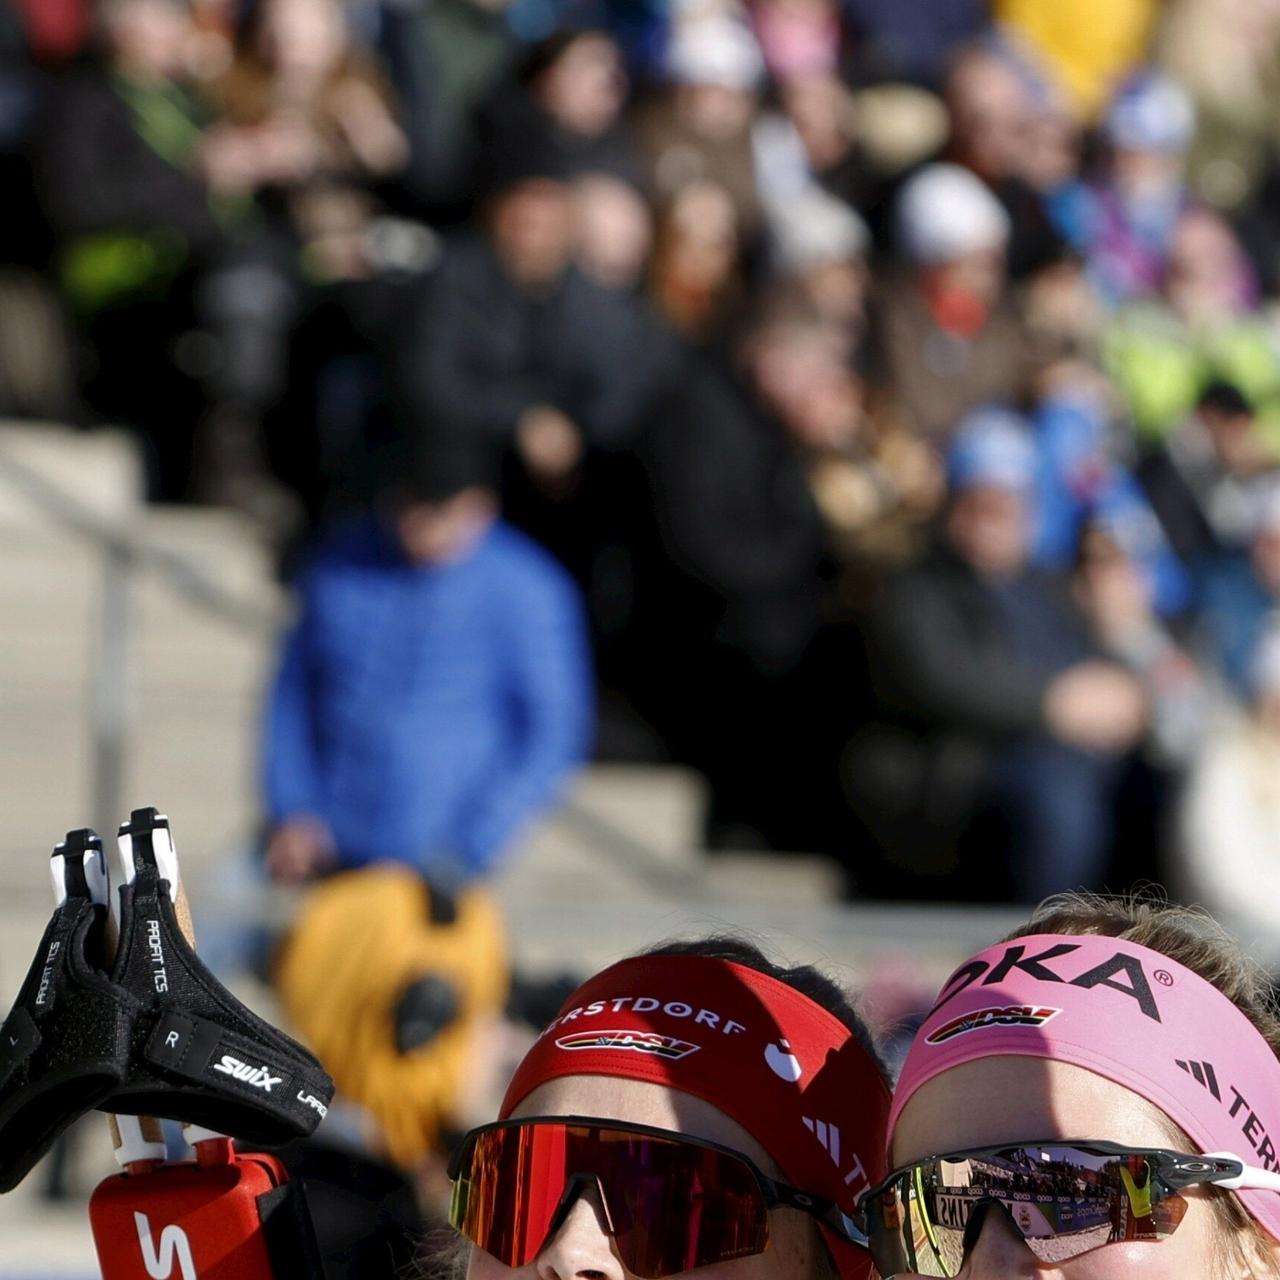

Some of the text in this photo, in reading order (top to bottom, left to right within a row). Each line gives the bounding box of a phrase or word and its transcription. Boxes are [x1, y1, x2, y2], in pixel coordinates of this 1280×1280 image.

[926, 944, 1162, 1024] OKA
[540, 996, 747, 1037] ERSTDORF
[165, 1030, 180, 1048] R
